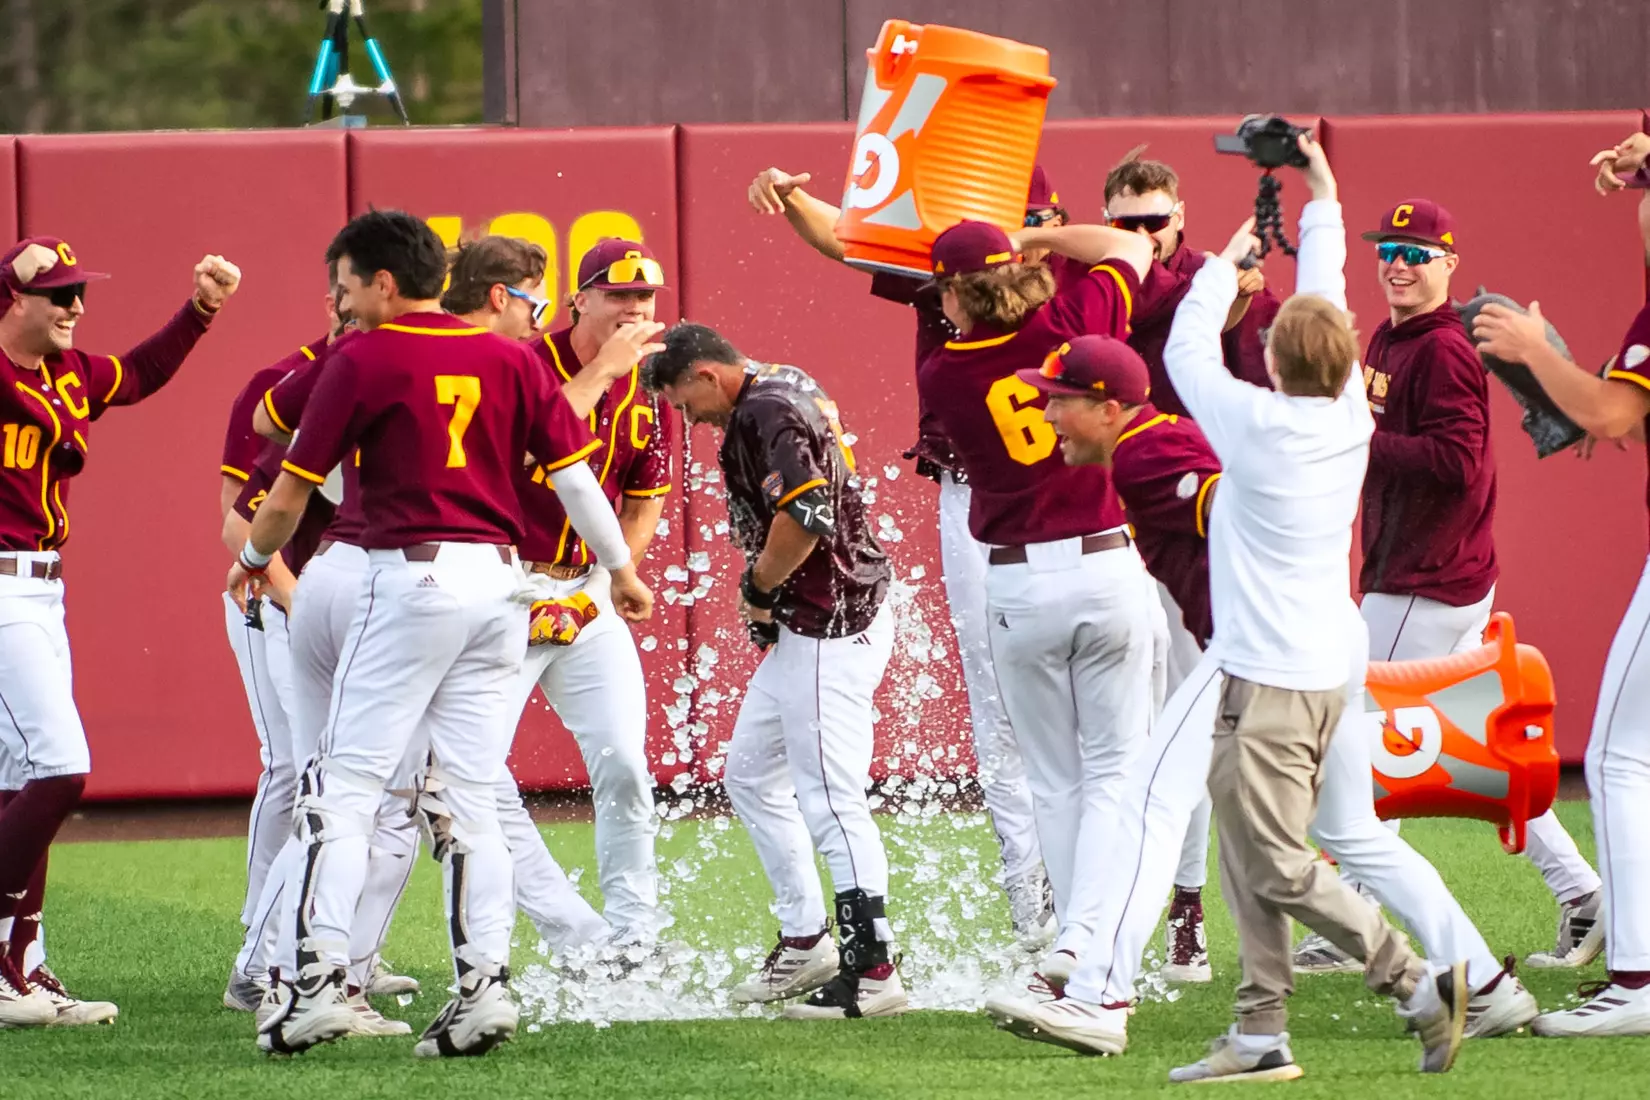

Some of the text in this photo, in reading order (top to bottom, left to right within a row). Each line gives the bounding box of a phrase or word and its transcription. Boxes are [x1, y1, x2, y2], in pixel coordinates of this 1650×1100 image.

[1392, 204, 1414, 227] C
[57, 242, 77, 267] C
[55, 371, 90, 419] C
[434, 374, 481, 468] 7
[630, 404, 654, 450] C
[985, 373, 1058, 466] 6
[3, 423, 42, 470] 10
[1370, 705, 1443, 779] G
